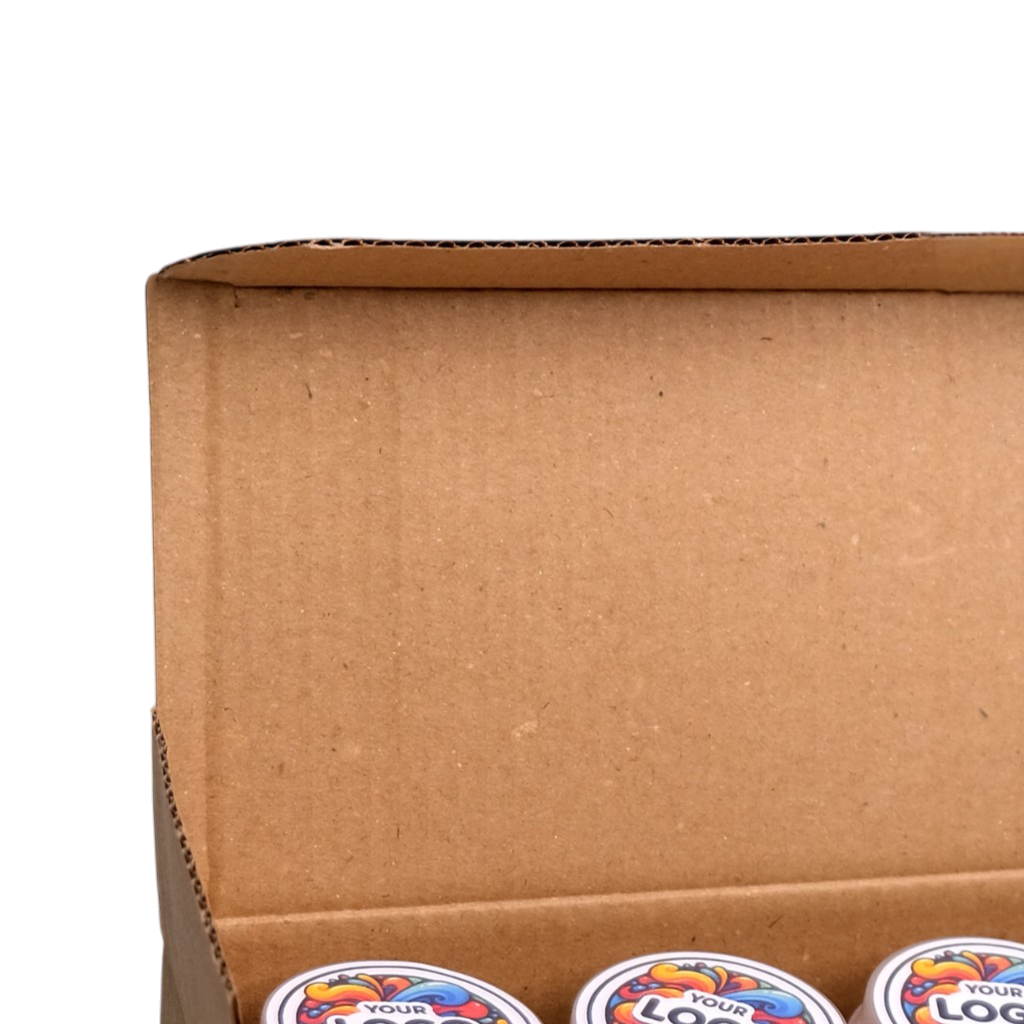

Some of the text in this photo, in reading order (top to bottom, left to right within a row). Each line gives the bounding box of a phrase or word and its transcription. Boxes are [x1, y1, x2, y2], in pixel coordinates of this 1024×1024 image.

[966, 984, 1023, 998] YOUR
[364, 1004, 426, 1016] YOUR
[691, 992, 747, 1017] YOUR
